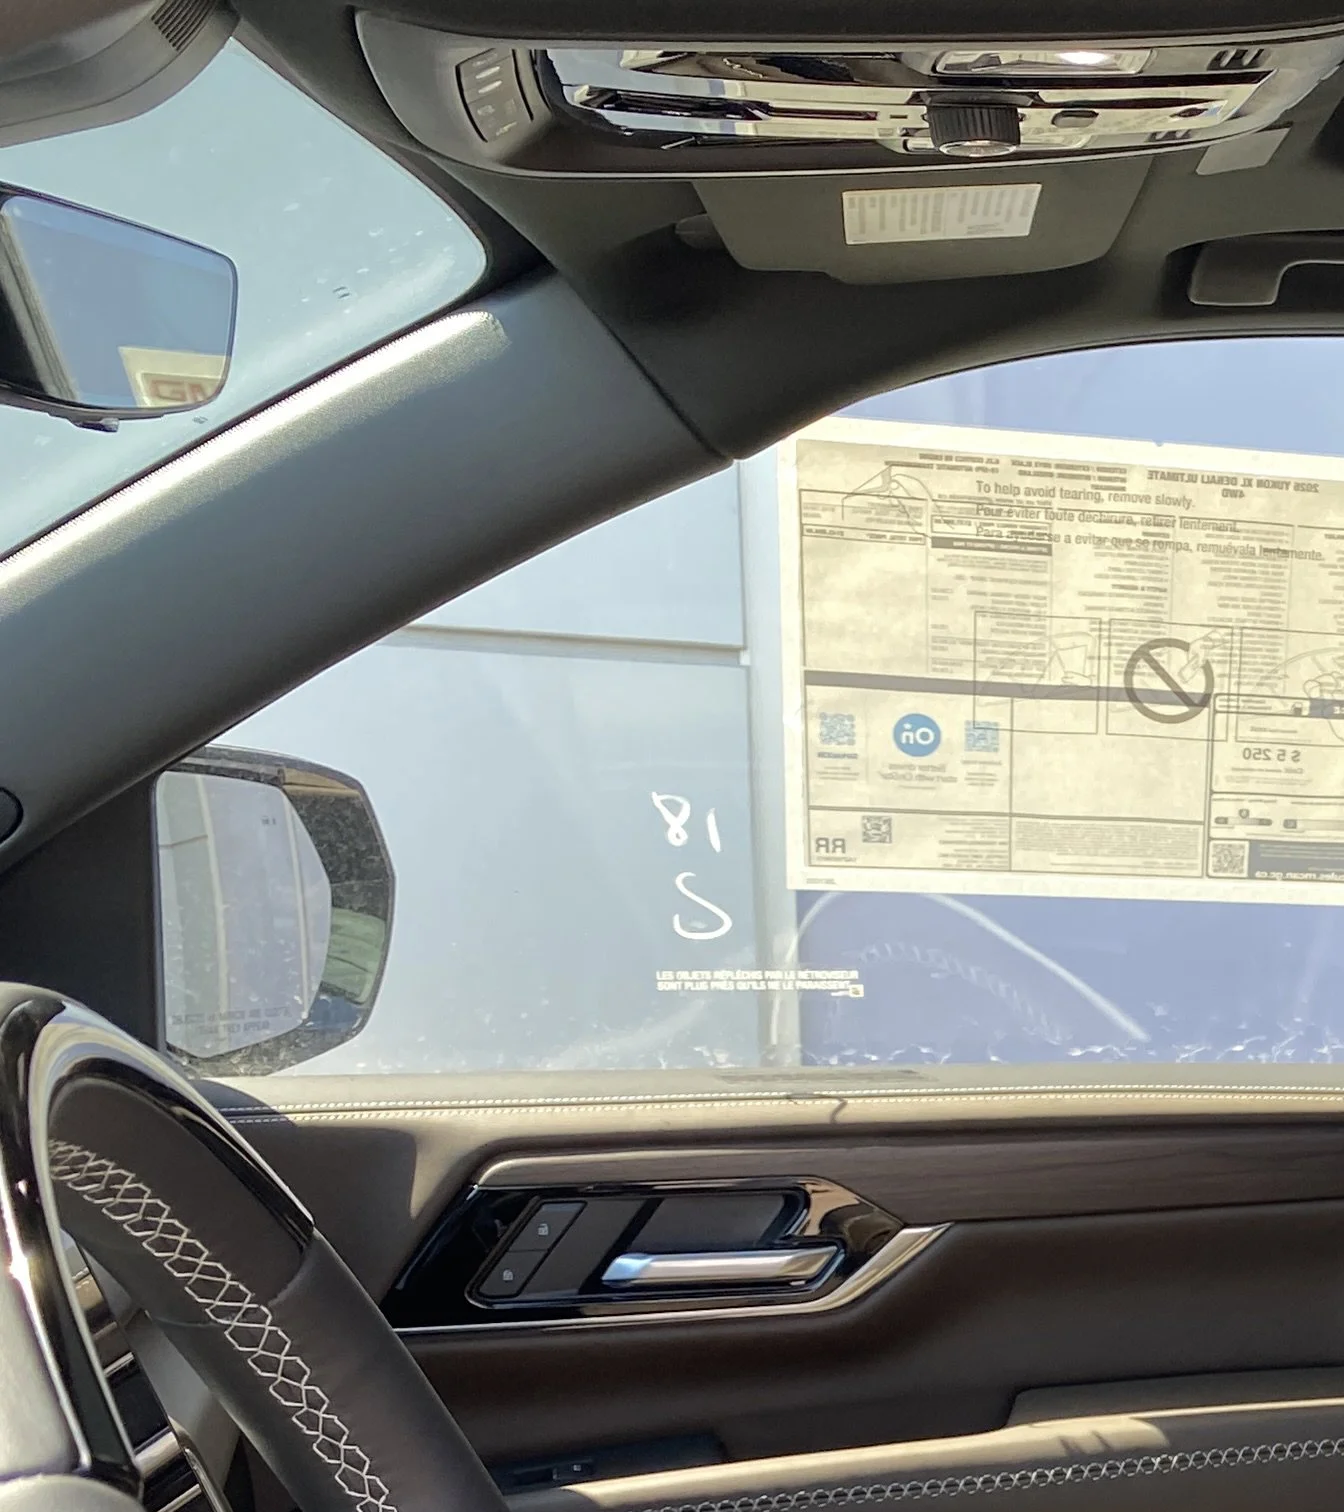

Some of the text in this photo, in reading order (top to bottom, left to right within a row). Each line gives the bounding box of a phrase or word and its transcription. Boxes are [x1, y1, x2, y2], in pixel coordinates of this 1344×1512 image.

[976, 480, 991, 494] To
[994, 483, 1021, 497] help
[1024, 485, 1056, 499] avoid
[1060, 488, 1104, 504] tearing,
[1108, 492, 1152, 505] remove
[1155, 493, 1195, 510] slowly.
[976, 504, 1003, 517] Pour
[1044, 508, 1075, 522] toute
[976, 525, 1003, 539] Para
[1064, 535, 1072, 544] a
[1111, 537, 1133, 550] que
[1136, 538, 1150, 548] se
[1153, 540, 1193, 554] rompa,
